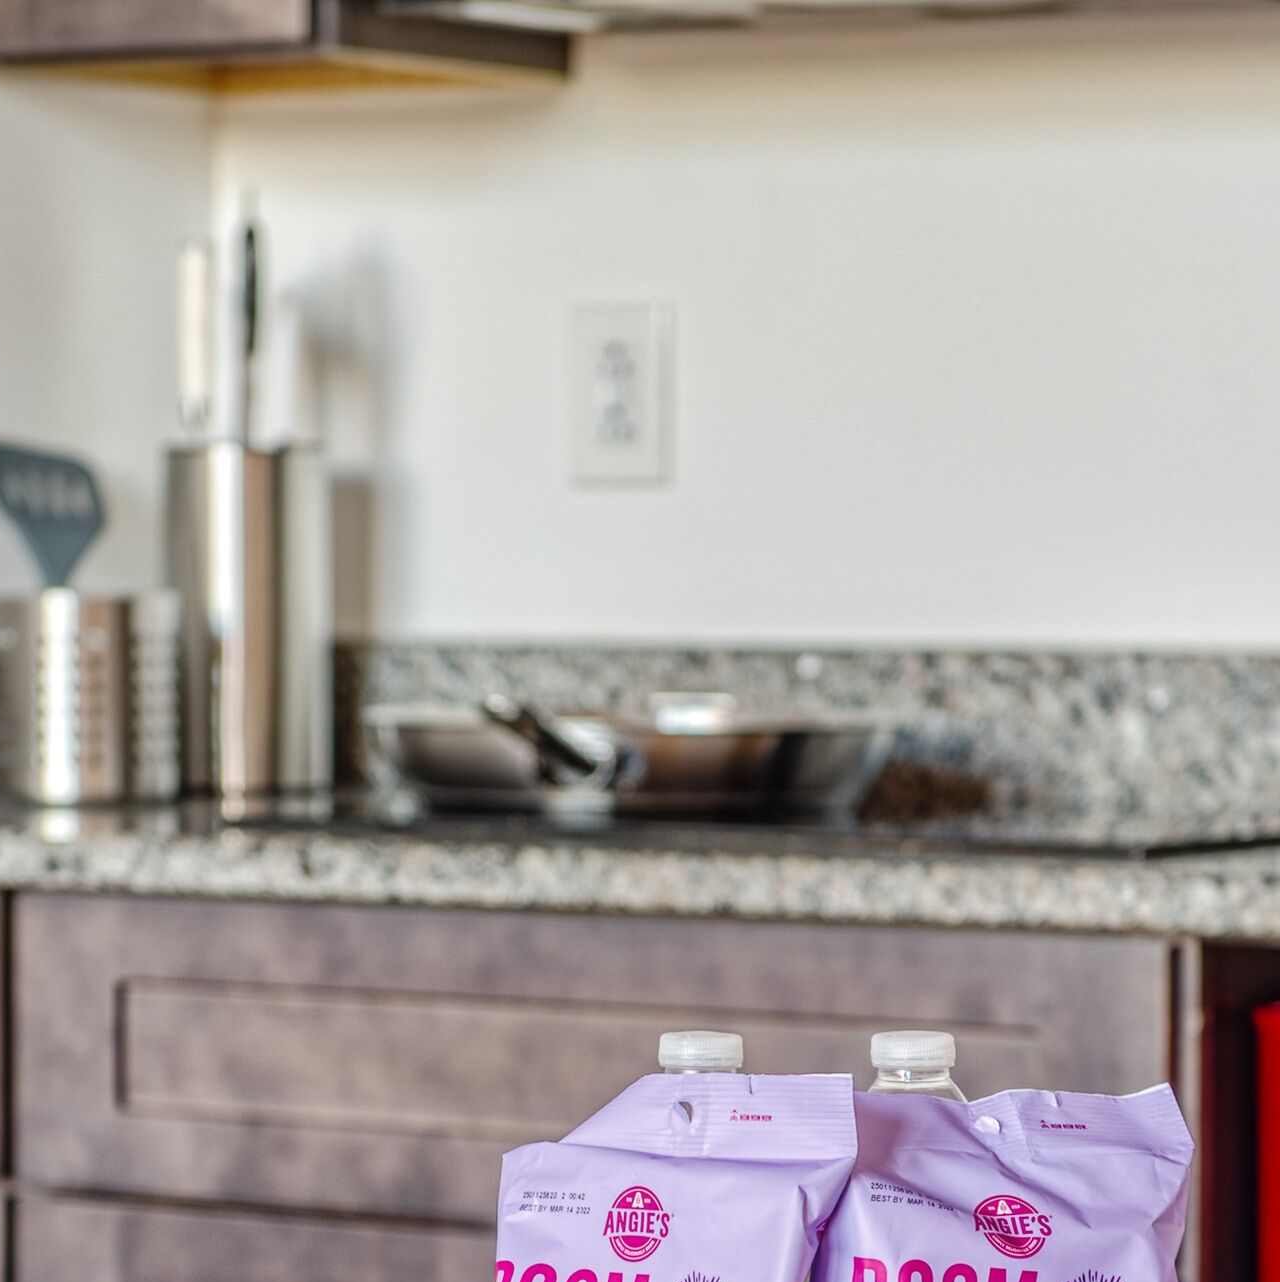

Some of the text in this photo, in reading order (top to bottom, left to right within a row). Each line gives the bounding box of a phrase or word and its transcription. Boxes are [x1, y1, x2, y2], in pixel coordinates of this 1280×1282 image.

[870, 1194, 892, 1203] BEST
[893, 1195, 904, 1204] BY
[519, 1204, 537, 1212] BEST
[538, 1204, 547, 1212] BY
[550, 1205, 564, 1213] MAR
[603, 1210, 670, 1238] ANGIE'S
[973, 1214, 1052, 1236] ANGIE'S
